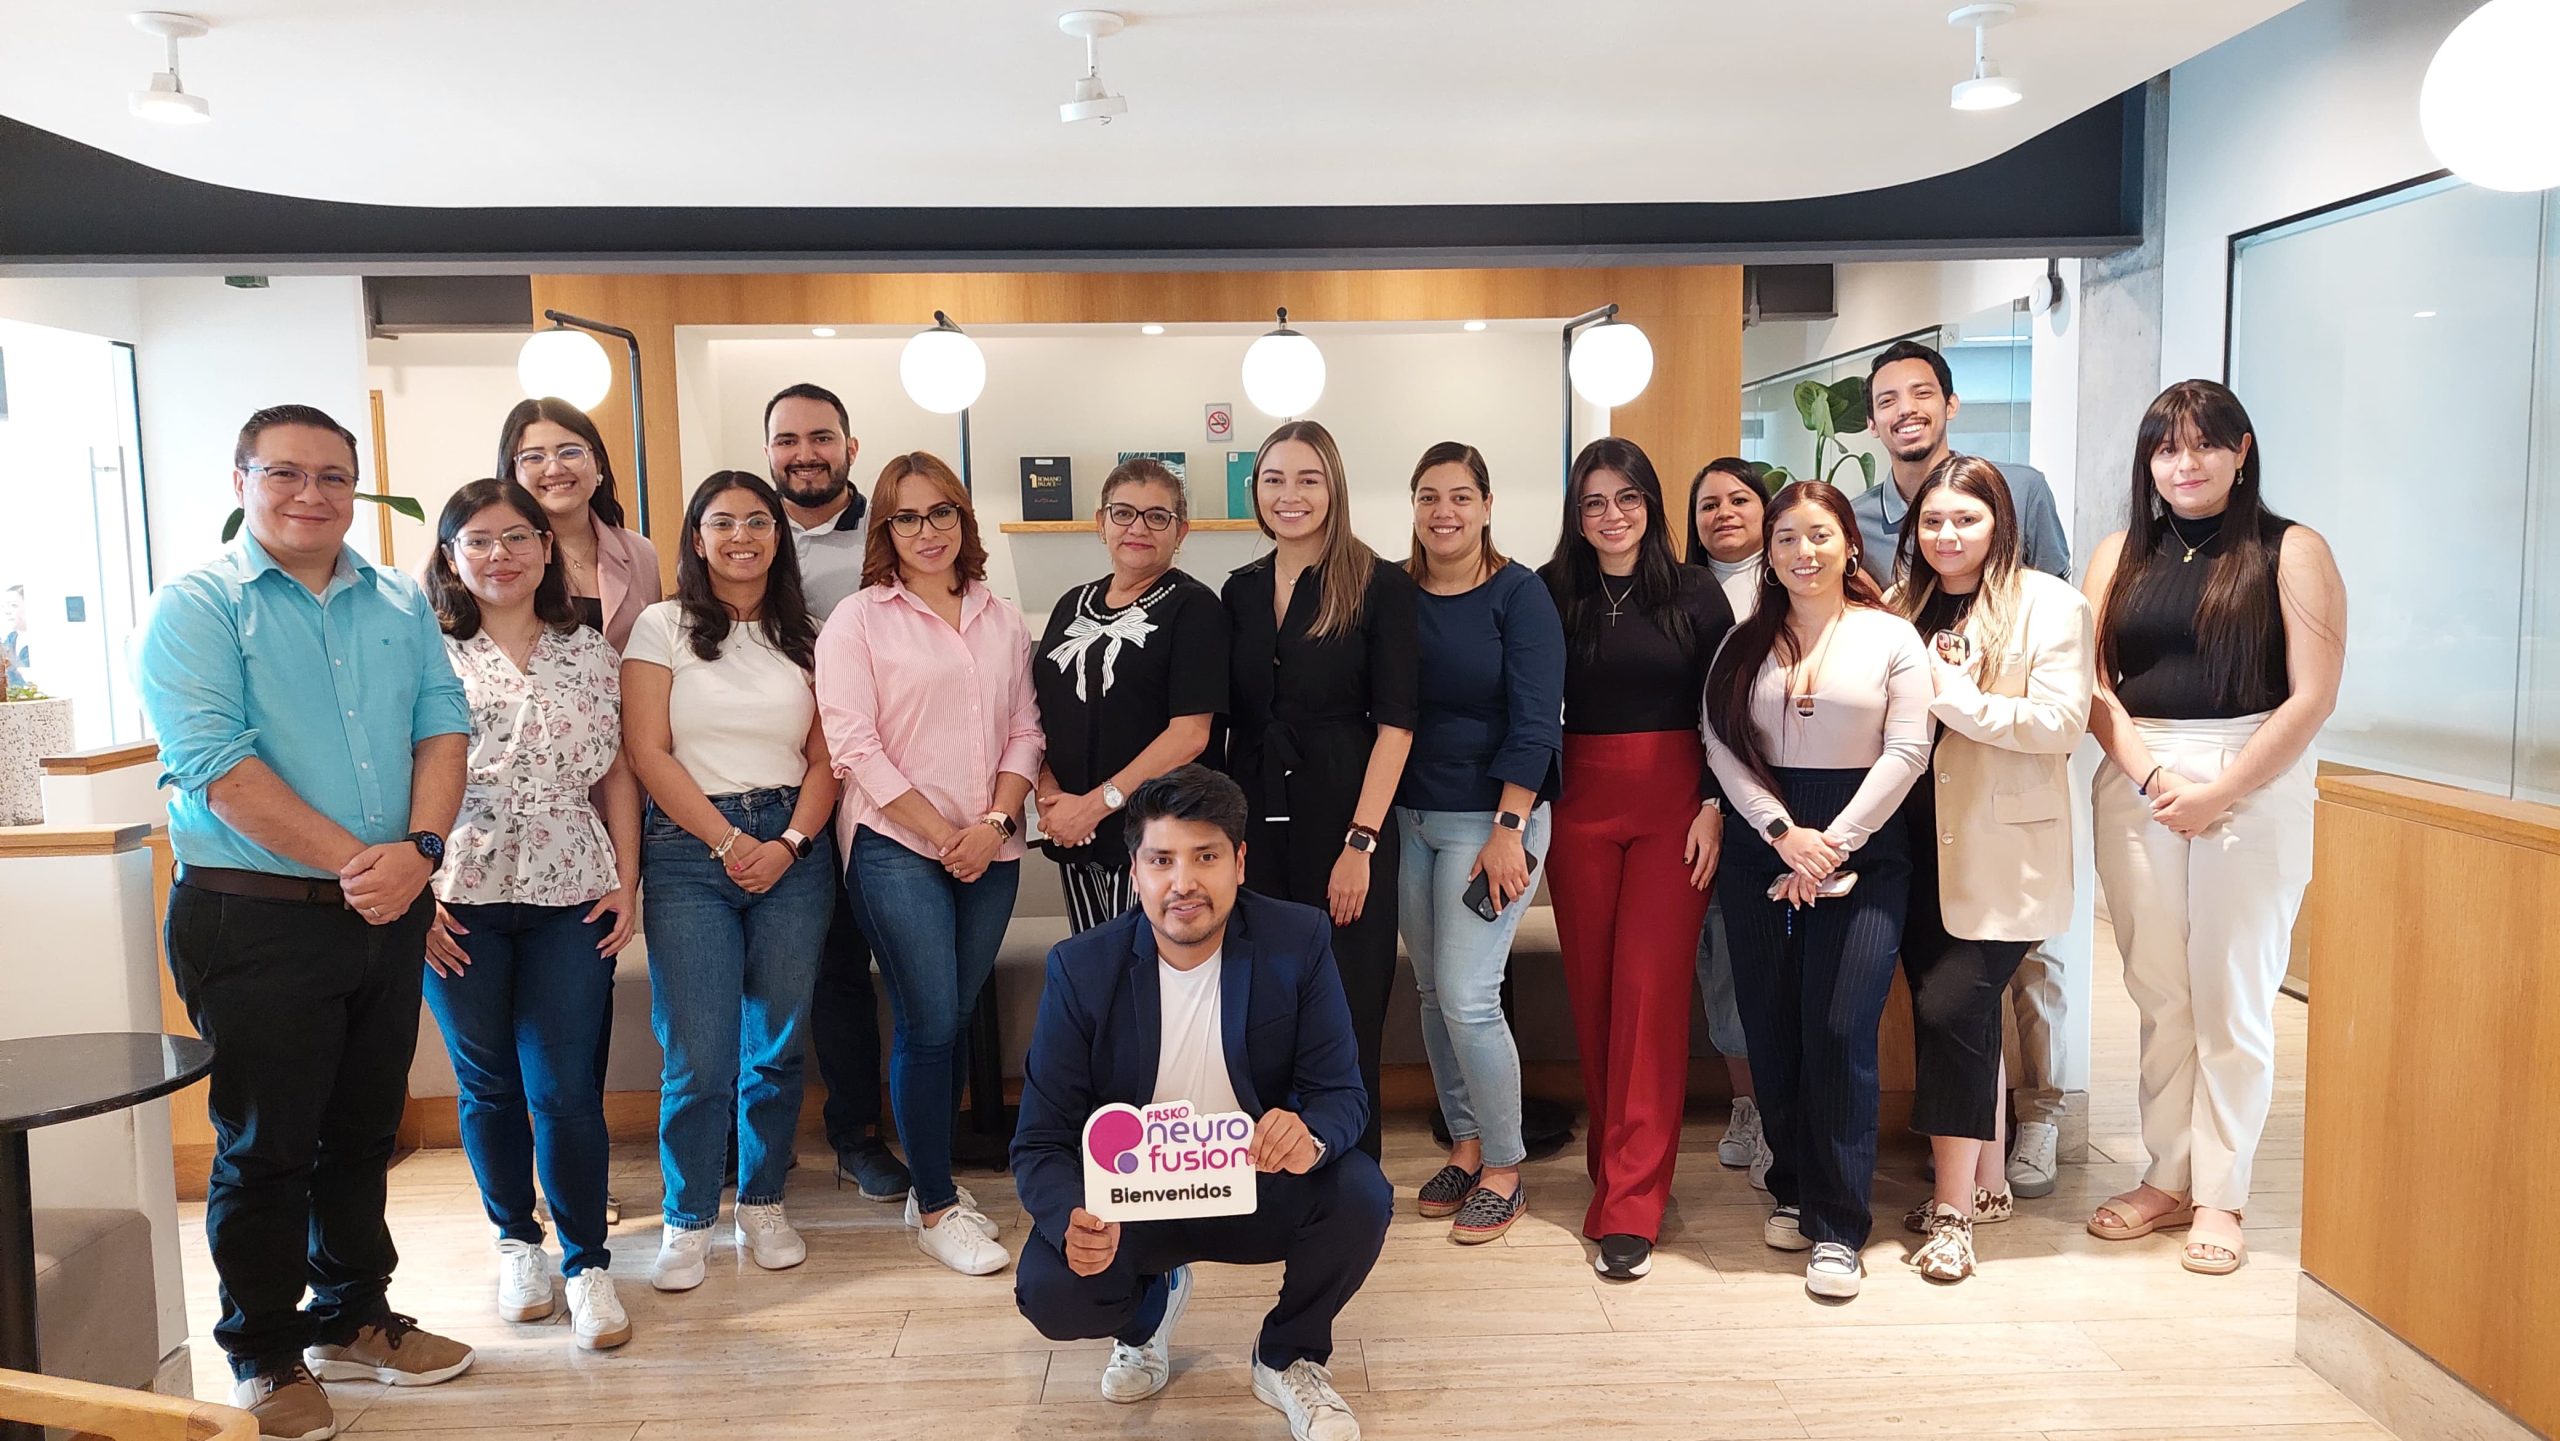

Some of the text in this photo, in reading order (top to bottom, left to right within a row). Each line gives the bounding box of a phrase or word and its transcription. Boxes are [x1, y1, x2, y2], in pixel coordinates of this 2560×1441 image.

[1146, 1106, 1189, 1123] FRSKO
[1147, 1118, 1249, 1145] neuro
[1148, 1142, 1251, 1173] fusion
[1111, 1183, 1232, 1204] Bienvenidos
